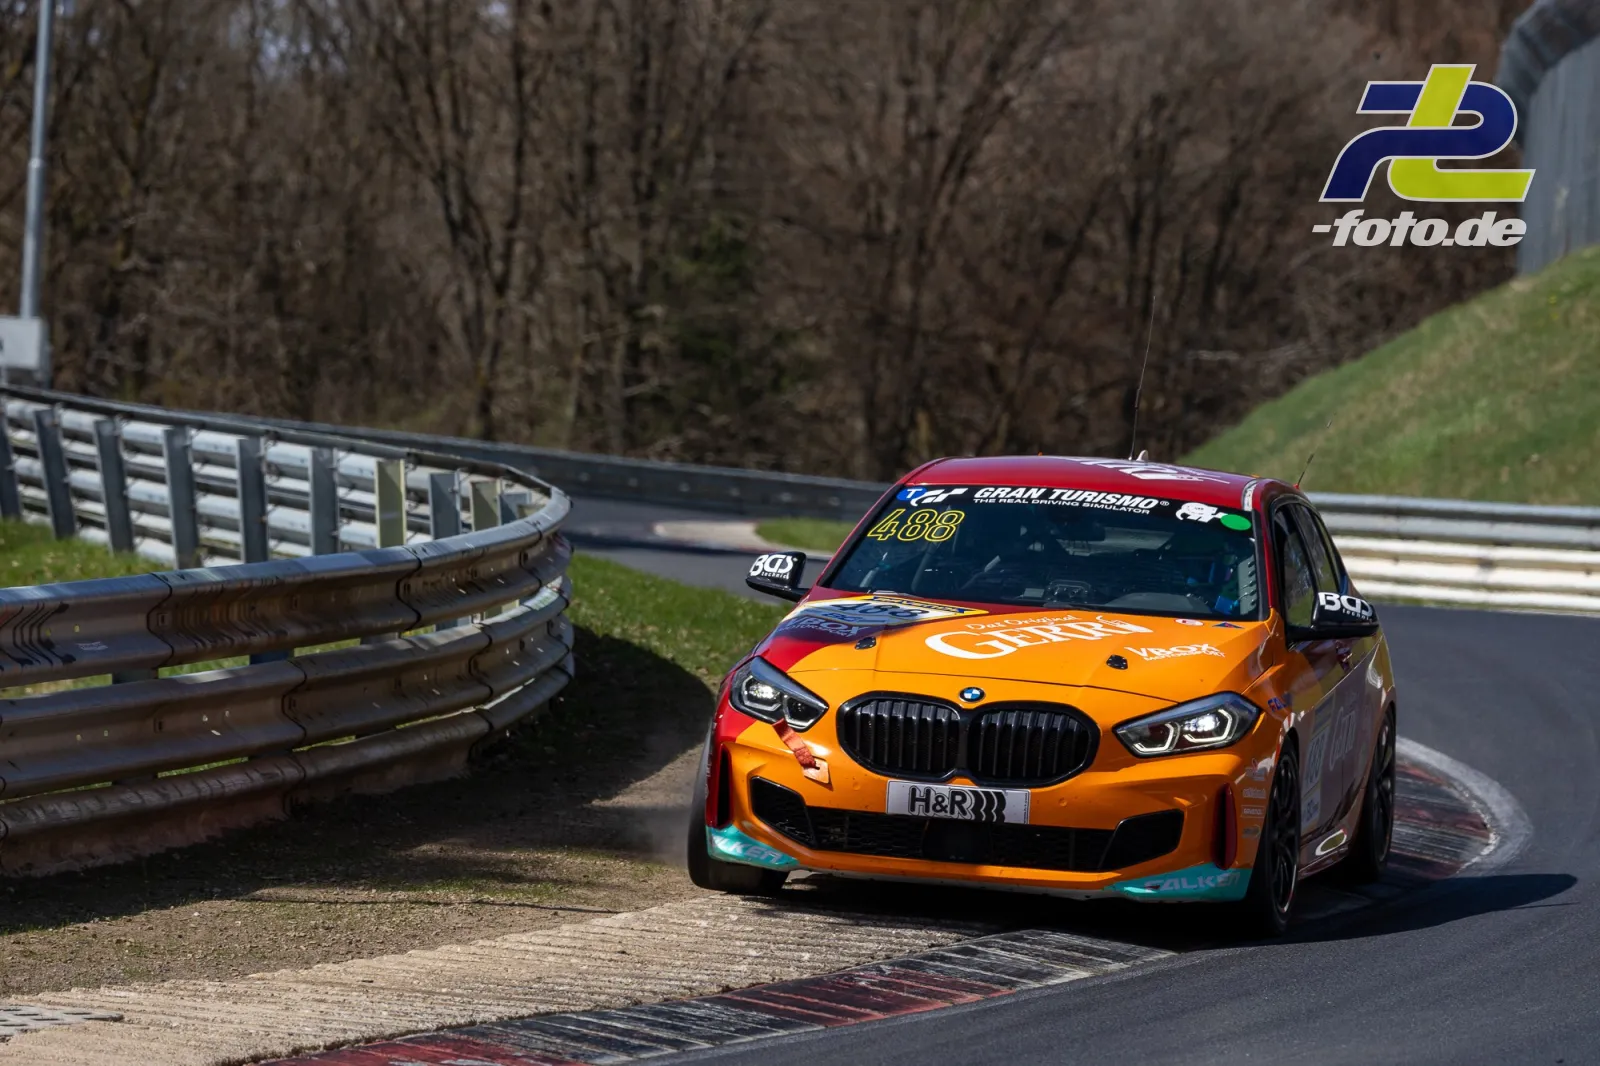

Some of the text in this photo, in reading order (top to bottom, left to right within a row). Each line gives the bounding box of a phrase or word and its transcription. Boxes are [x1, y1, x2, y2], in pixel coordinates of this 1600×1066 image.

[974, 487, 1047, 499] GRAN
[1031, 498, 1080, 507] DRIVING
[1082, 502, 1150, 515] SIMULATOR
[867, 508, 966, 542] 488
[831, 603, 930, 619] 488
[1003, 613, 1082, 627] Original
[908, 786, 970, 817] H&R
